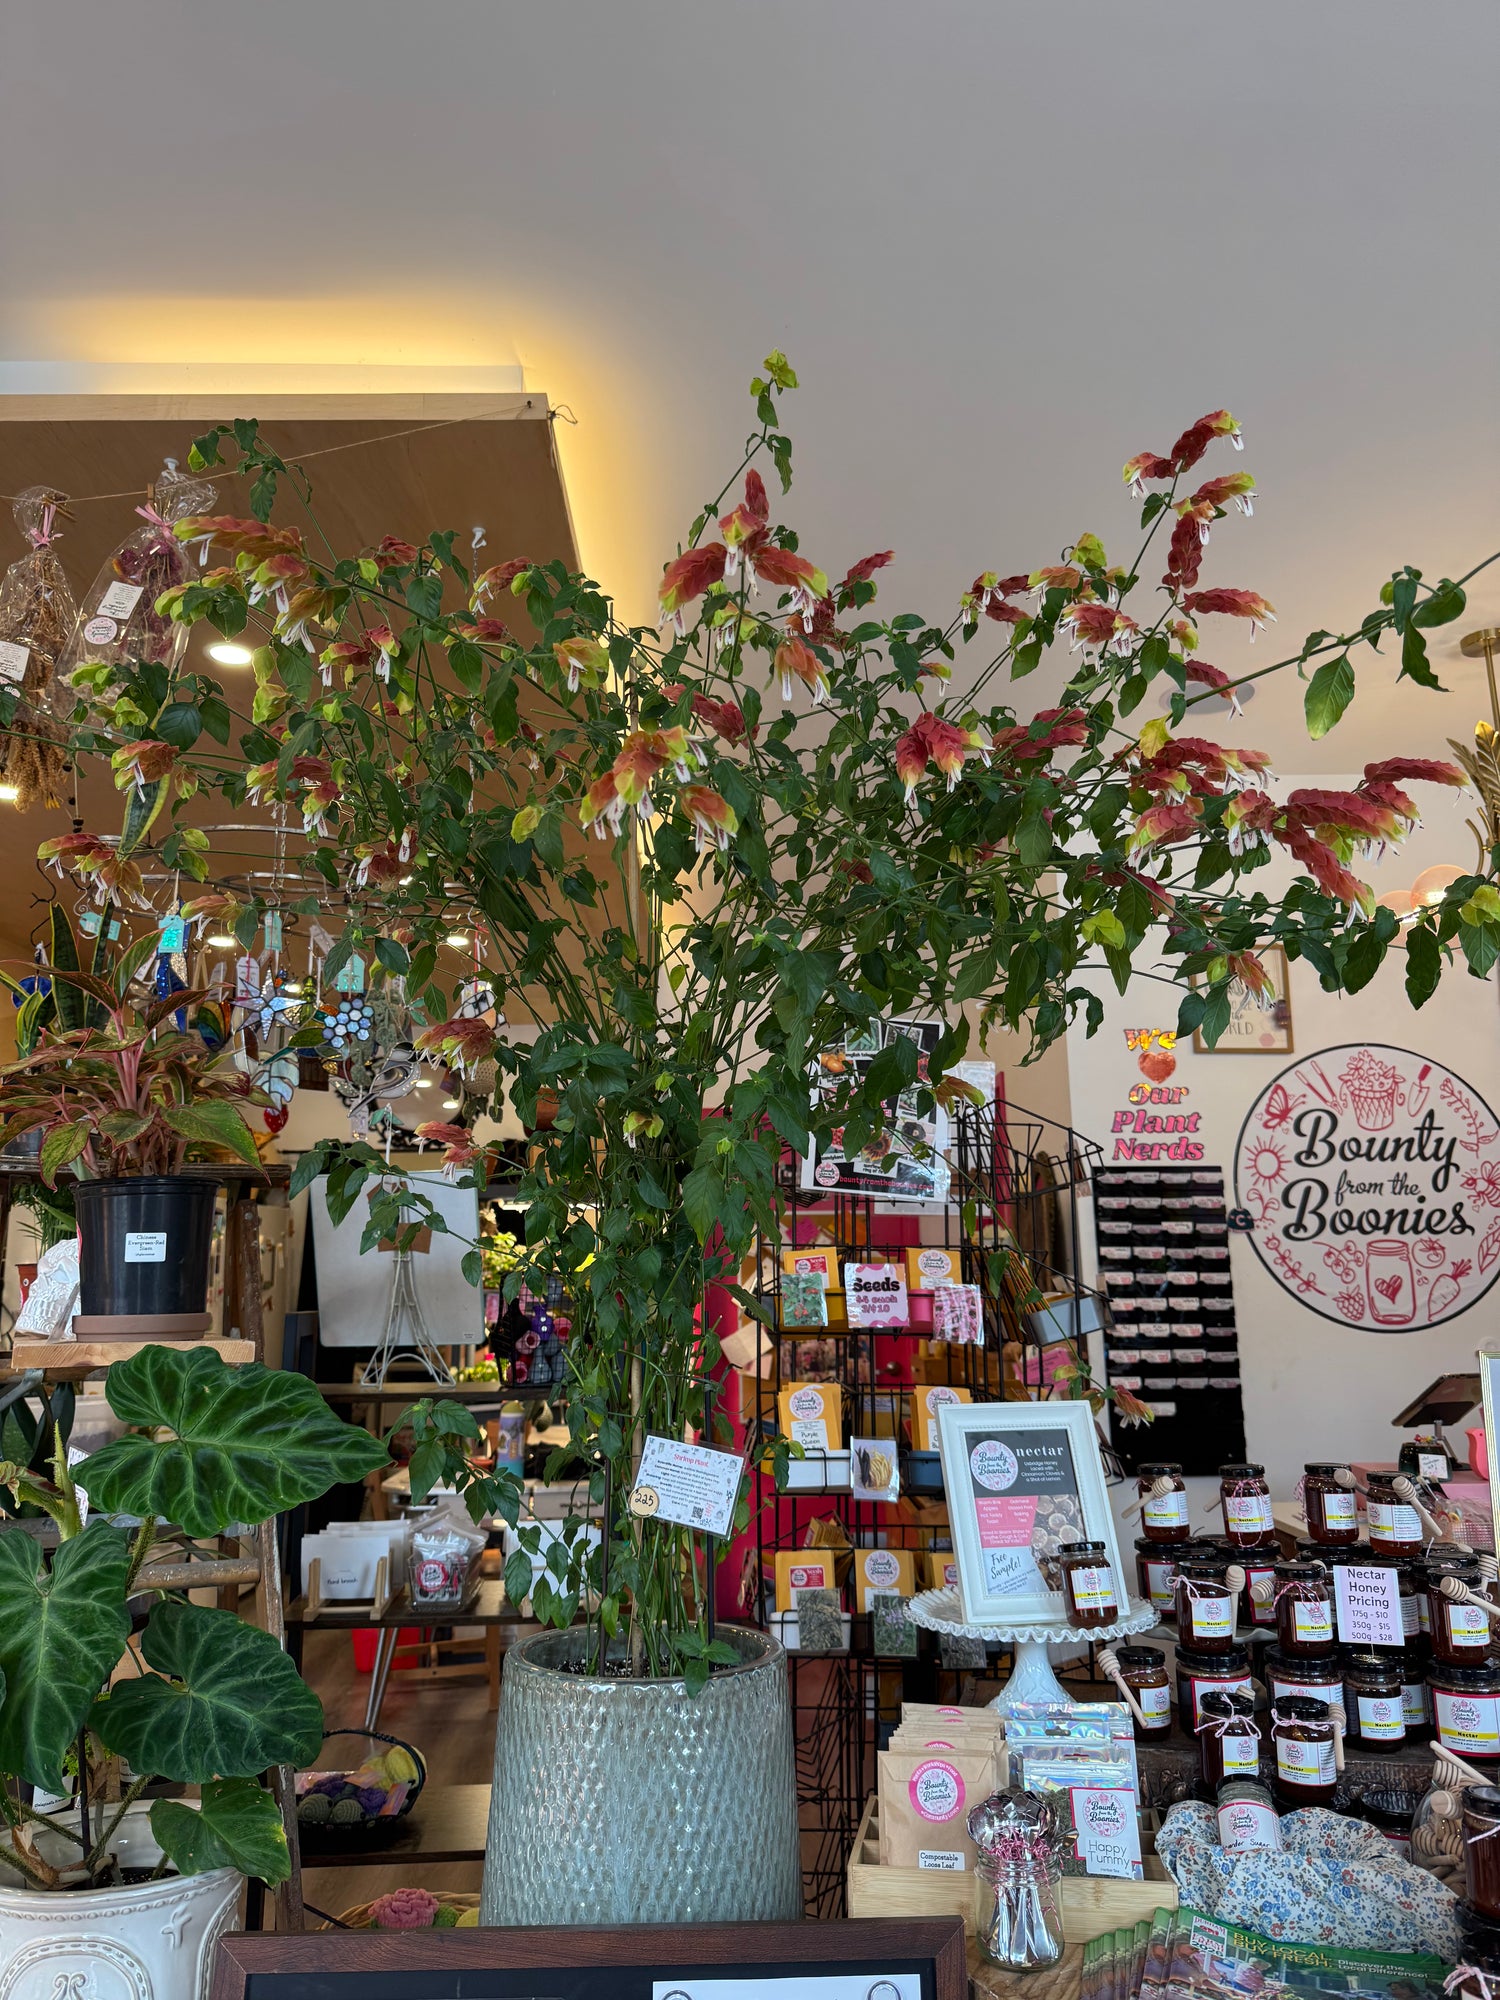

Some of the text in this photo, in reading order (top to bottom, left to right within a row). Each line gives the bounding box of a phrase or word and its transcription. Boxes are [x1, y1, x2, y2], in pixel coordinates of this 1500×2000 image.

[1123, 1028, 1178, 1052] We
[1128, 1082, 1190, 1106] Our
[1110, 1108, 1202, 1134] Plant
[1111, 1136, 1205, 1161] Nerds
[1292, 1108, 1461, 1193] Bounty
[1335, 1169, 1421, 1207] from the
[1281, 1178, 1476, 1243] Boonies
[852, 1276, 901, 1293] Seeds
[978, 1451, 1008, 1467] Bounty
[1015, 1445, 1065, 1458] nectar
[977, 1463, 1012, 1476] Boonies
[991, 1552, 1008, 1566] Free
[990, 1556, 1021, 1580] Sample!
[1347, 1567, 1386, 1581] Nectar
[1349, 1581, 1387, 1596] Honey
[1348, 1595, 1390, 1610] Pricing
[1352, 1609, 1369, 1619] 175g
[1375, 1610, 1389, 1619] $10
[1352, 1620, 1372, 1631] 350g
[1378, 1622, 1391, 1631] $15
[1351, 1632, 1372, 1642] 500g
[1378, 1633, 1393, 1642] $28
[923, 1778, 949, 1791] Bounty
[922, 1791, 952, 1802] Boonies
[1090, 1801, 1118, 1816] Bounty
[1089, 1811, 1121, 1824] Boonies
[1088, 1839, 1128, 1858] Happy
[1249, 1838, 1271, 1848] Sugar
[920, 1852, 959, 1862] Compostable
[924, 1860, 955, 1869] Loose Leaf
[1088, 1850, 1130, 1870] Tummy
[1233, 1932, 1268, 1948] BUY
[1233, 1939, 1333, 1968] BUY FRESH.
[1337, 1959, 1405, 1971] Discover the
[1338, 1964, 1429, 1979] Local Difference!
